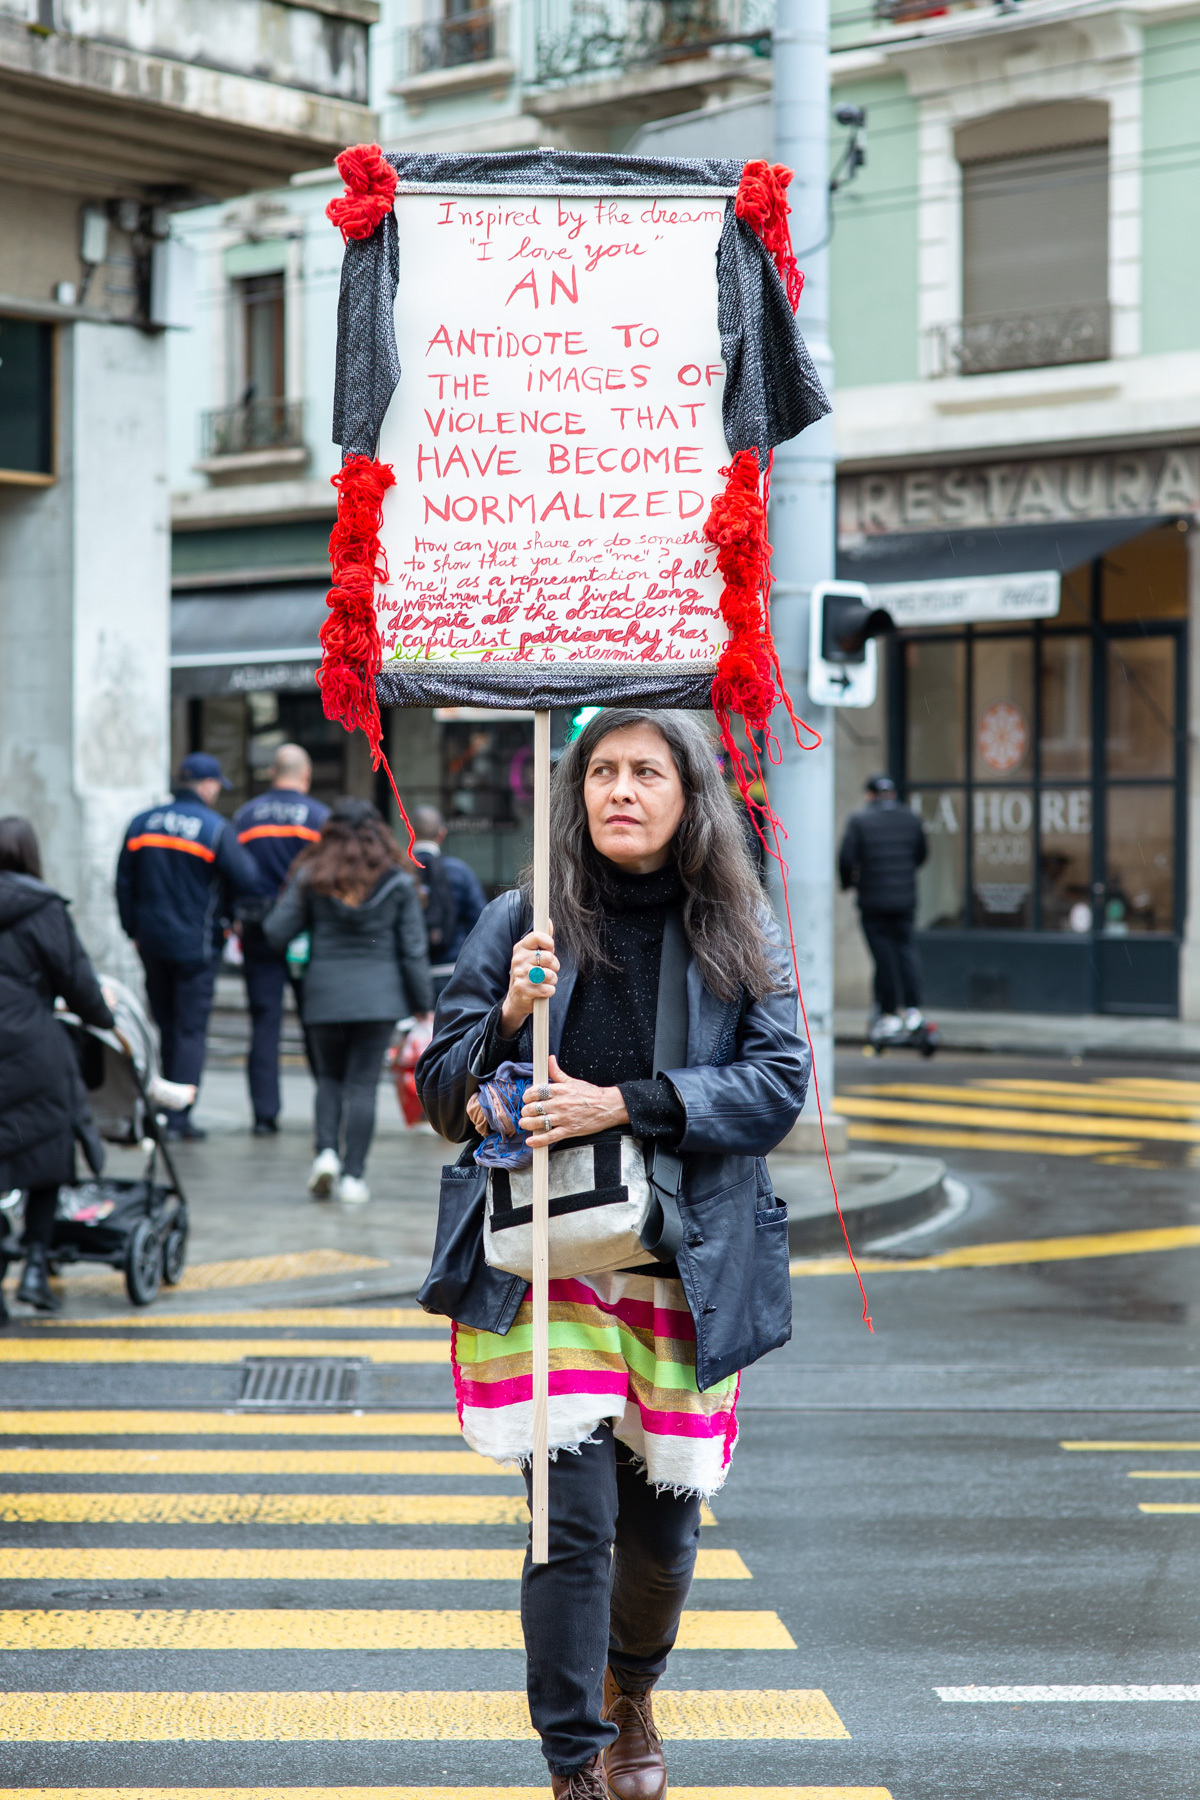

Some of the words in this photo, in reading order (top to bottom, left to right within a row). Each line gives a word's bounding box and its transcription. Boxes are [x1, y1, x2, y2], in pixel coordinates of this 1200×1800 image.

[437, 201, 541, 239] Inspired
[557, 198, 588, 239] by
[594, 198, 630, 226] the
[640, 200, 724, 224] dream
[507, 236, 573, 261] love
[585, 234, 664, 271] you"
[505, 264, 579, 309] AN
[611, 323, 659, 348] TO
[427, 373, 490, 400] THE
[677, 364, 725, 387] OF
[610, 403, 706, 430] THAT
[417, 443, 522, 482] HAVE
[547, 443, 704, 475] BECOME
[422, 490, 704, 525] NORMALIZED
[857, 452, 1198, 529] RESTAURA
[415, 535, 447, 553] How
[453, 540, 482, 551] can
[487, 539, 518, 558] you
[523, 530, 571, 550] share
[578, 538, 598, 547] or
[603, 532, 631, 547] do
[404, 555, 425, 572] to
[433, 553, 472, 573] show
[478, 553, 517, 569] that
[531, 557, 562, 576] you
[568, 550, 604, 564] love
[457, 576, 481, 589] as
[488, 576, 506, 586] a
[510, 567, 650, 592] representation
[659, 558, 683, 589] of
[684, 559, 712, 579] all
[376, 593, 400, 613] the
[482, 588, 525, 607] that
[535, 586, 571, 602] had
[578, 583, 635, 602] lived
[642, 583, 704, 607] long
[419, 587, 447, 601] and
[450, 592, 481, 605] men
[387, 607, 475, 636] despite
[481, 606, 519, 626] all
[523, 602, 559, 622] the
[380, 631, 398, 650] hat
[402, 628, 511, 659] capitalist
[520, 620, 662, 661] patriarchy
[667, 617, 709, 643] has
[387, 643, 445, 661] life
[540, 646, 556, 662] to
